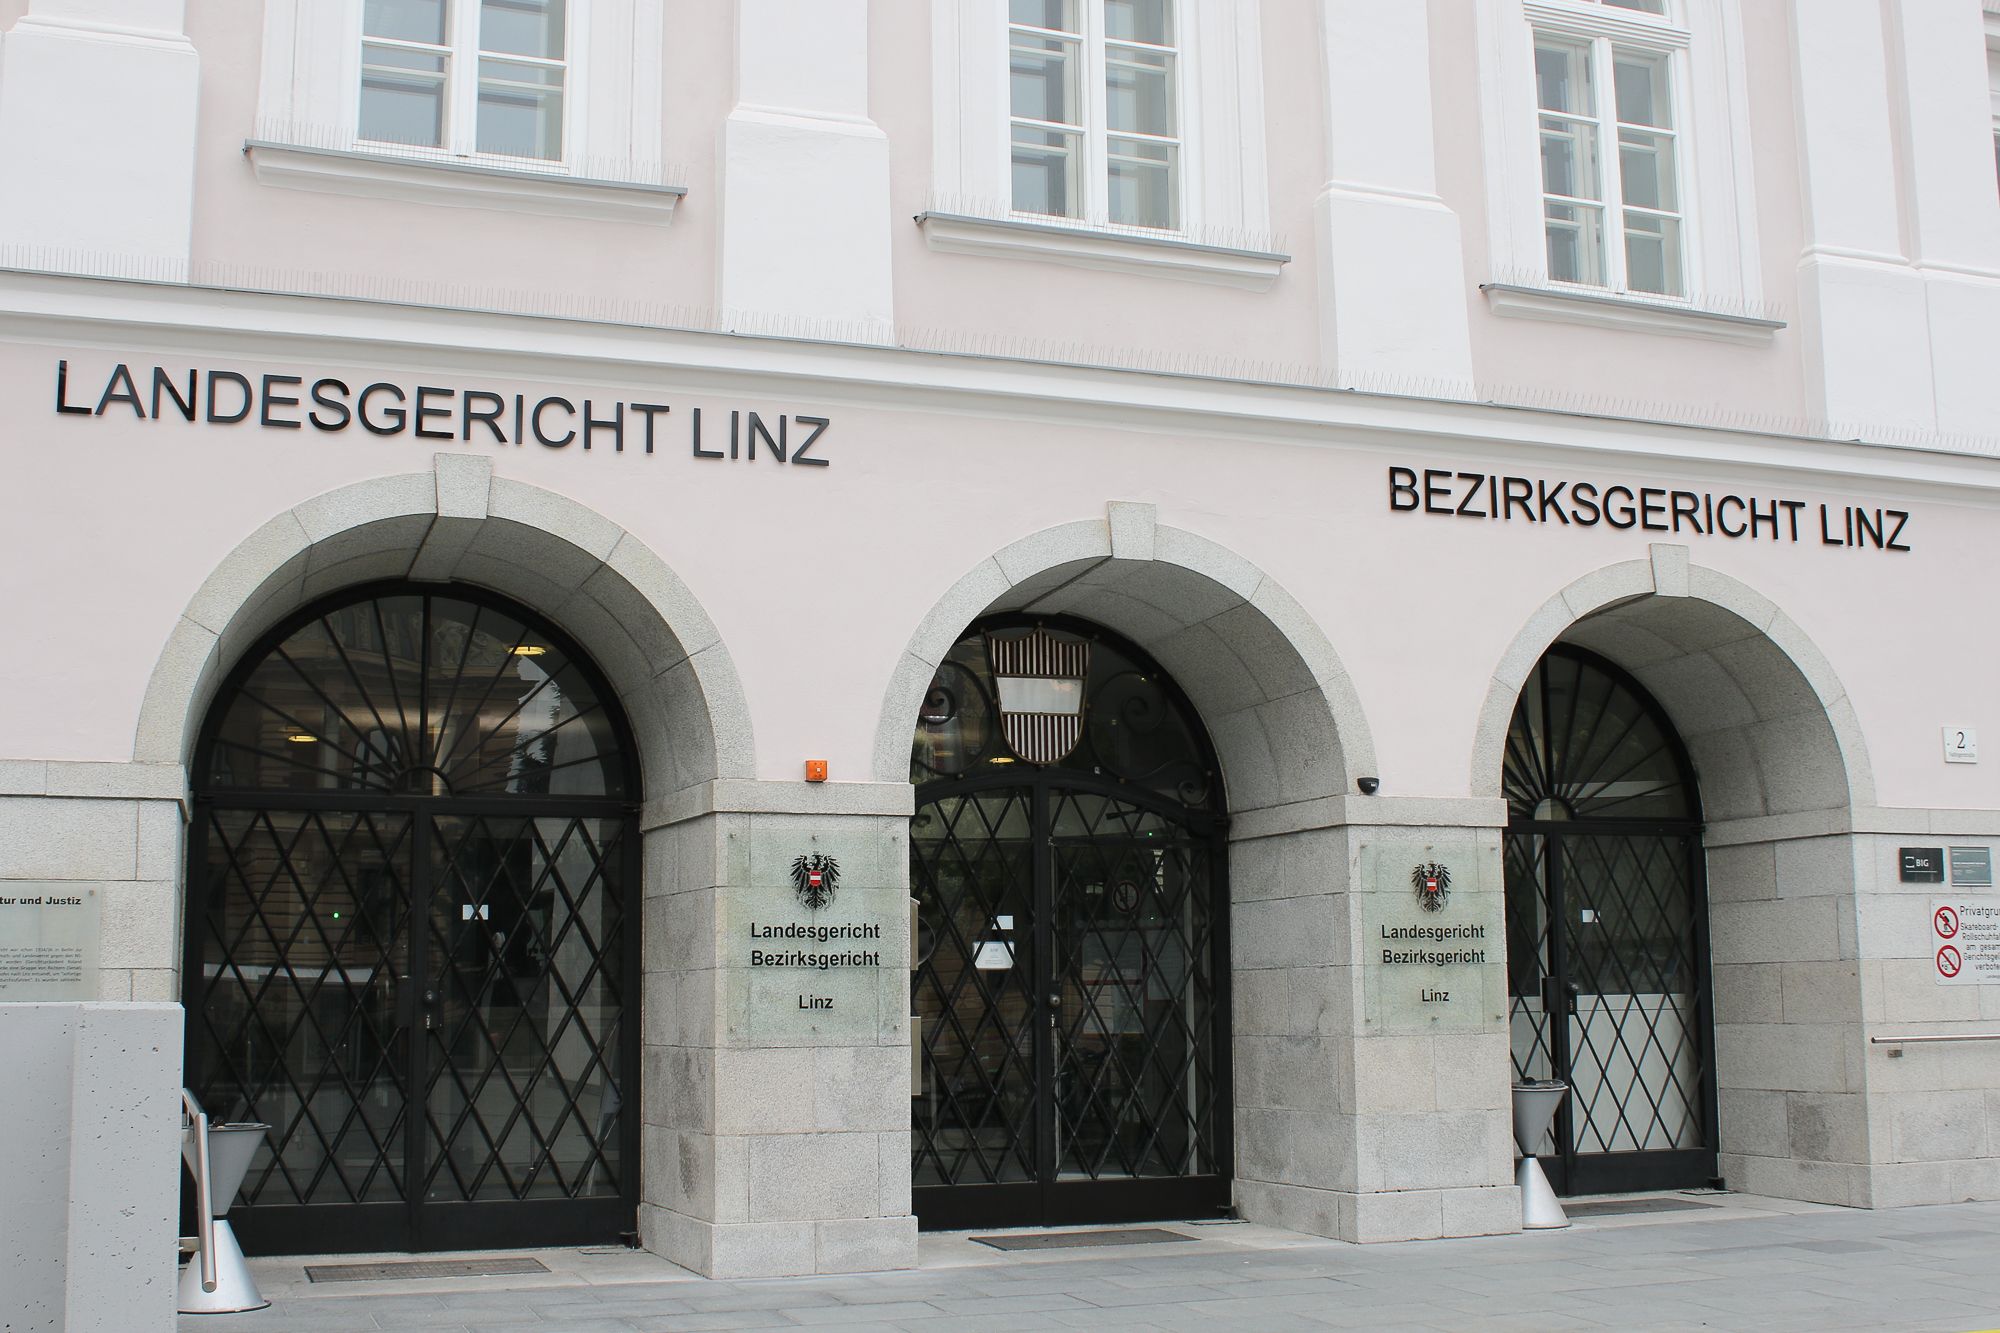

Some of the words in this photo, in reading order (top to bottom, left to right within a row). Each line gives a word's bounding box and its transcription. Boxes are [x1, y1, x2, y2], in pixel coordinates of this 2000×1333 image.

[56, 359, 670, 454] LANDESGERICHT
[693, 407, 830, 467] LINZ
[1388, 466, 1806, 542] BEZIRKSGERICHT
[1819, 503, 1911, 552] LINZ
[1957, 731, 1966, 749] 2
[1915, 859, 1929, 867] BIG
[20, 896, 42, 905] und
[45, 896, 82, 905] Justiz
[1960, 905, 2000, 918] Privatgru
[751, 922, 881, 942] Landesgericht
[1381, 924, 1485, 942] Landesgericht
[751, 950, 880, 970] Bezirksgericht
[1382, 948, 1486, 967] Bezirksgericht
[798, 994, 834, 1010] Linz
[1421, 988, 1450, 1002] Linz
